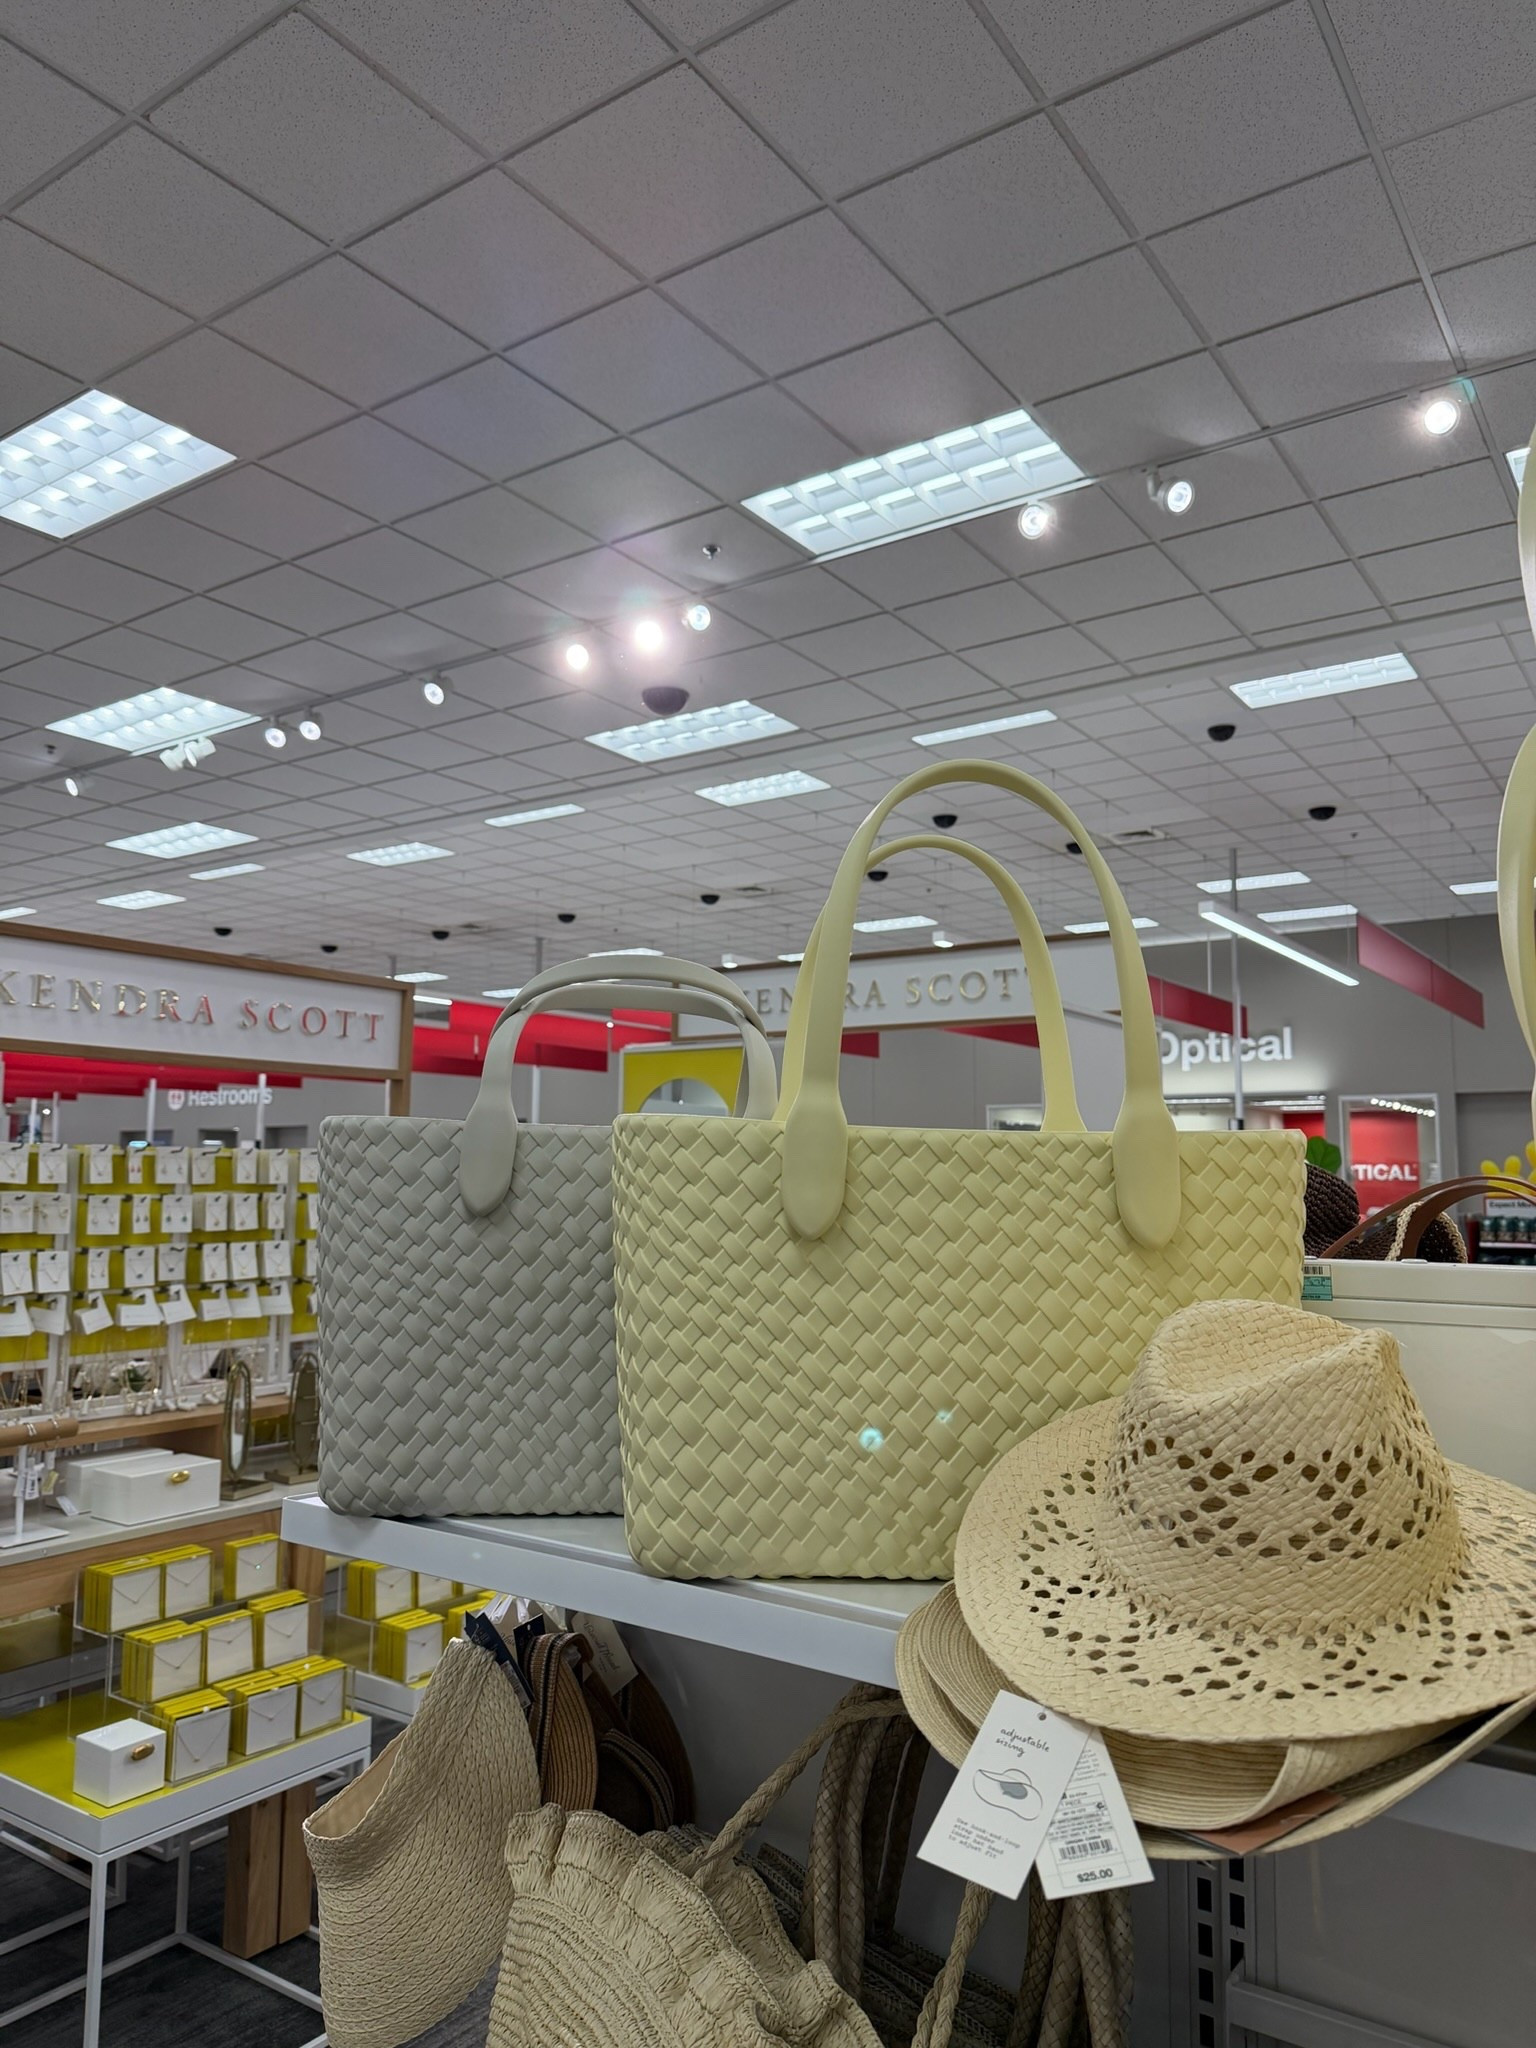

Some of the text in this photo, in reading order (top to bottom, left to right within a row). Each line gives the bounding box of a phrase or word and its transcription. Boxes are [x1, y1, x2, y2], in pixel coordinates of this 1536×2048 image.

[0, 971, 385, 1042] KENDRA SCOTT
[742, 966, 1028, 1015] ENRA SCOT
[1160, 1026, 1292, 1072] Optical
[996, 1737, 1025, 1758] sizing
[1000, 1728, 1050, 1752] adjustable
[1077, 1868, 1114, 1883] $25.00
